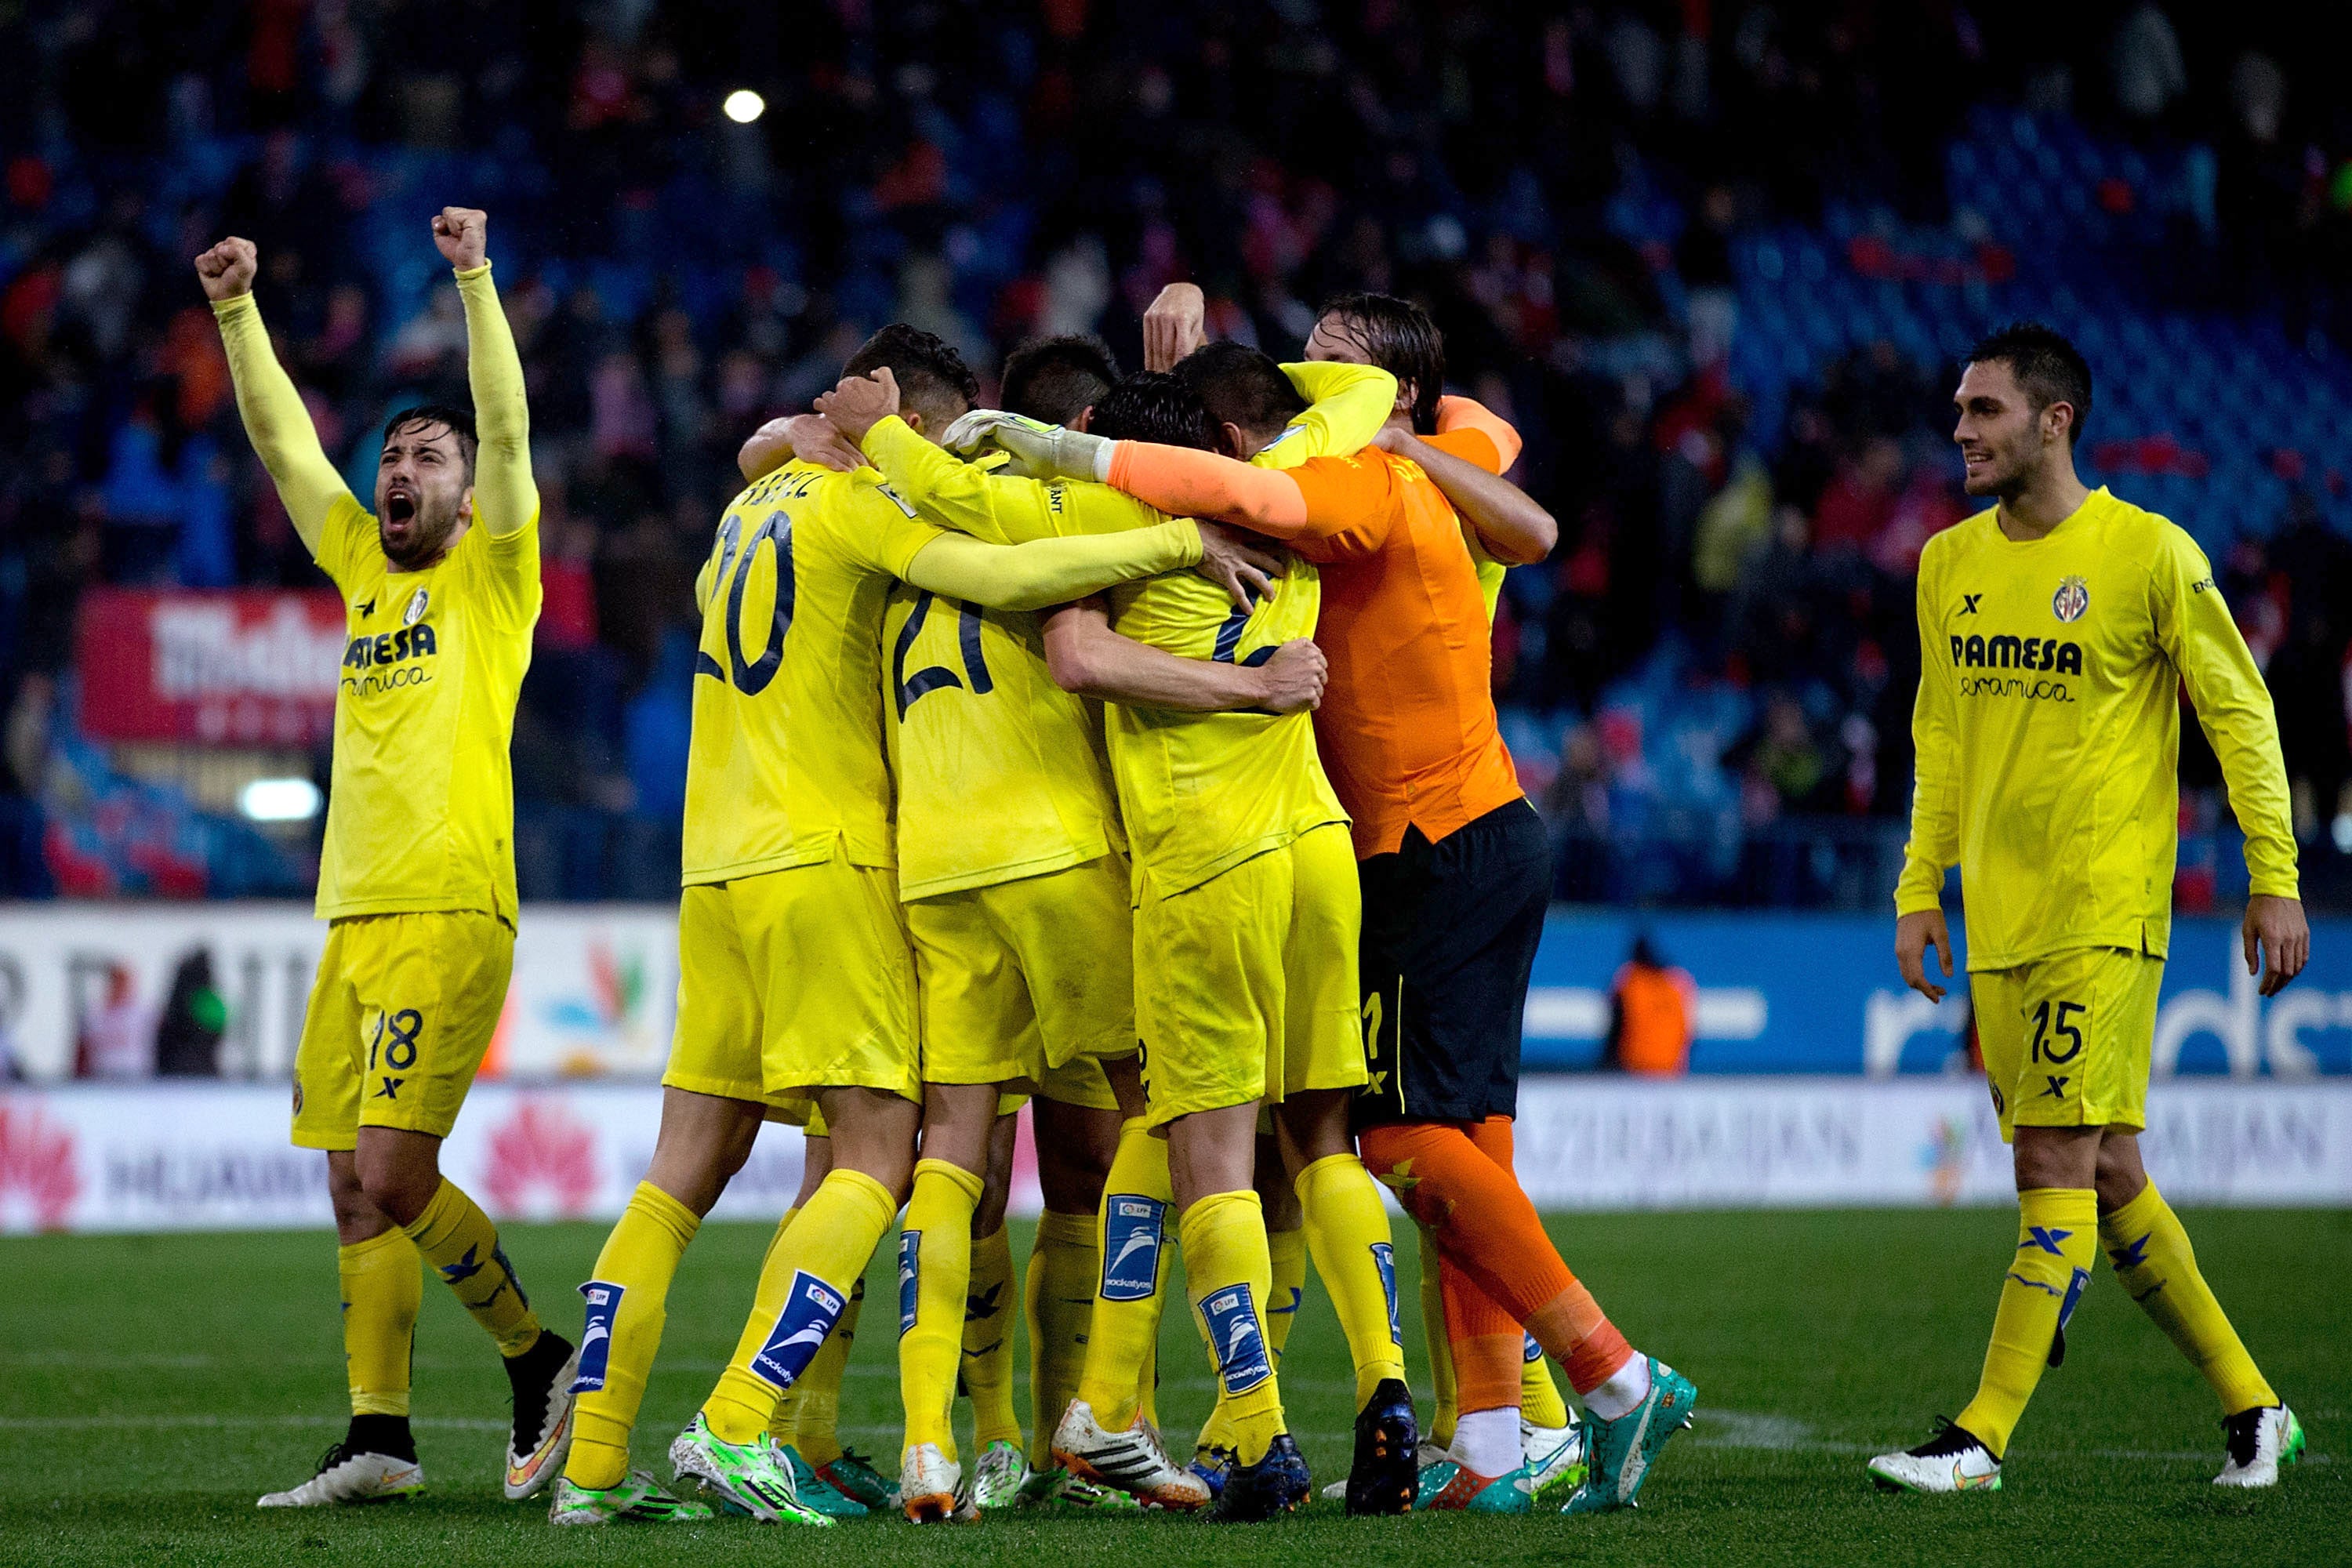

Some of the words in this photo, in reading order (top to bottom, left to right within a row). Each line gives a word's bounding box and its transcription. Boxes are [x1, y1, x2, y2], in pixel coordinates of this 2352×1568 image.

[1950, 635, 2082, 676] PAMESA
[1960, 677, 2074, 702] eramica
[370, 1008, 423, 1071] 18
[2031, 1000, 2086, 1064] 15
[826, 1298, 838, 1310] LFP
